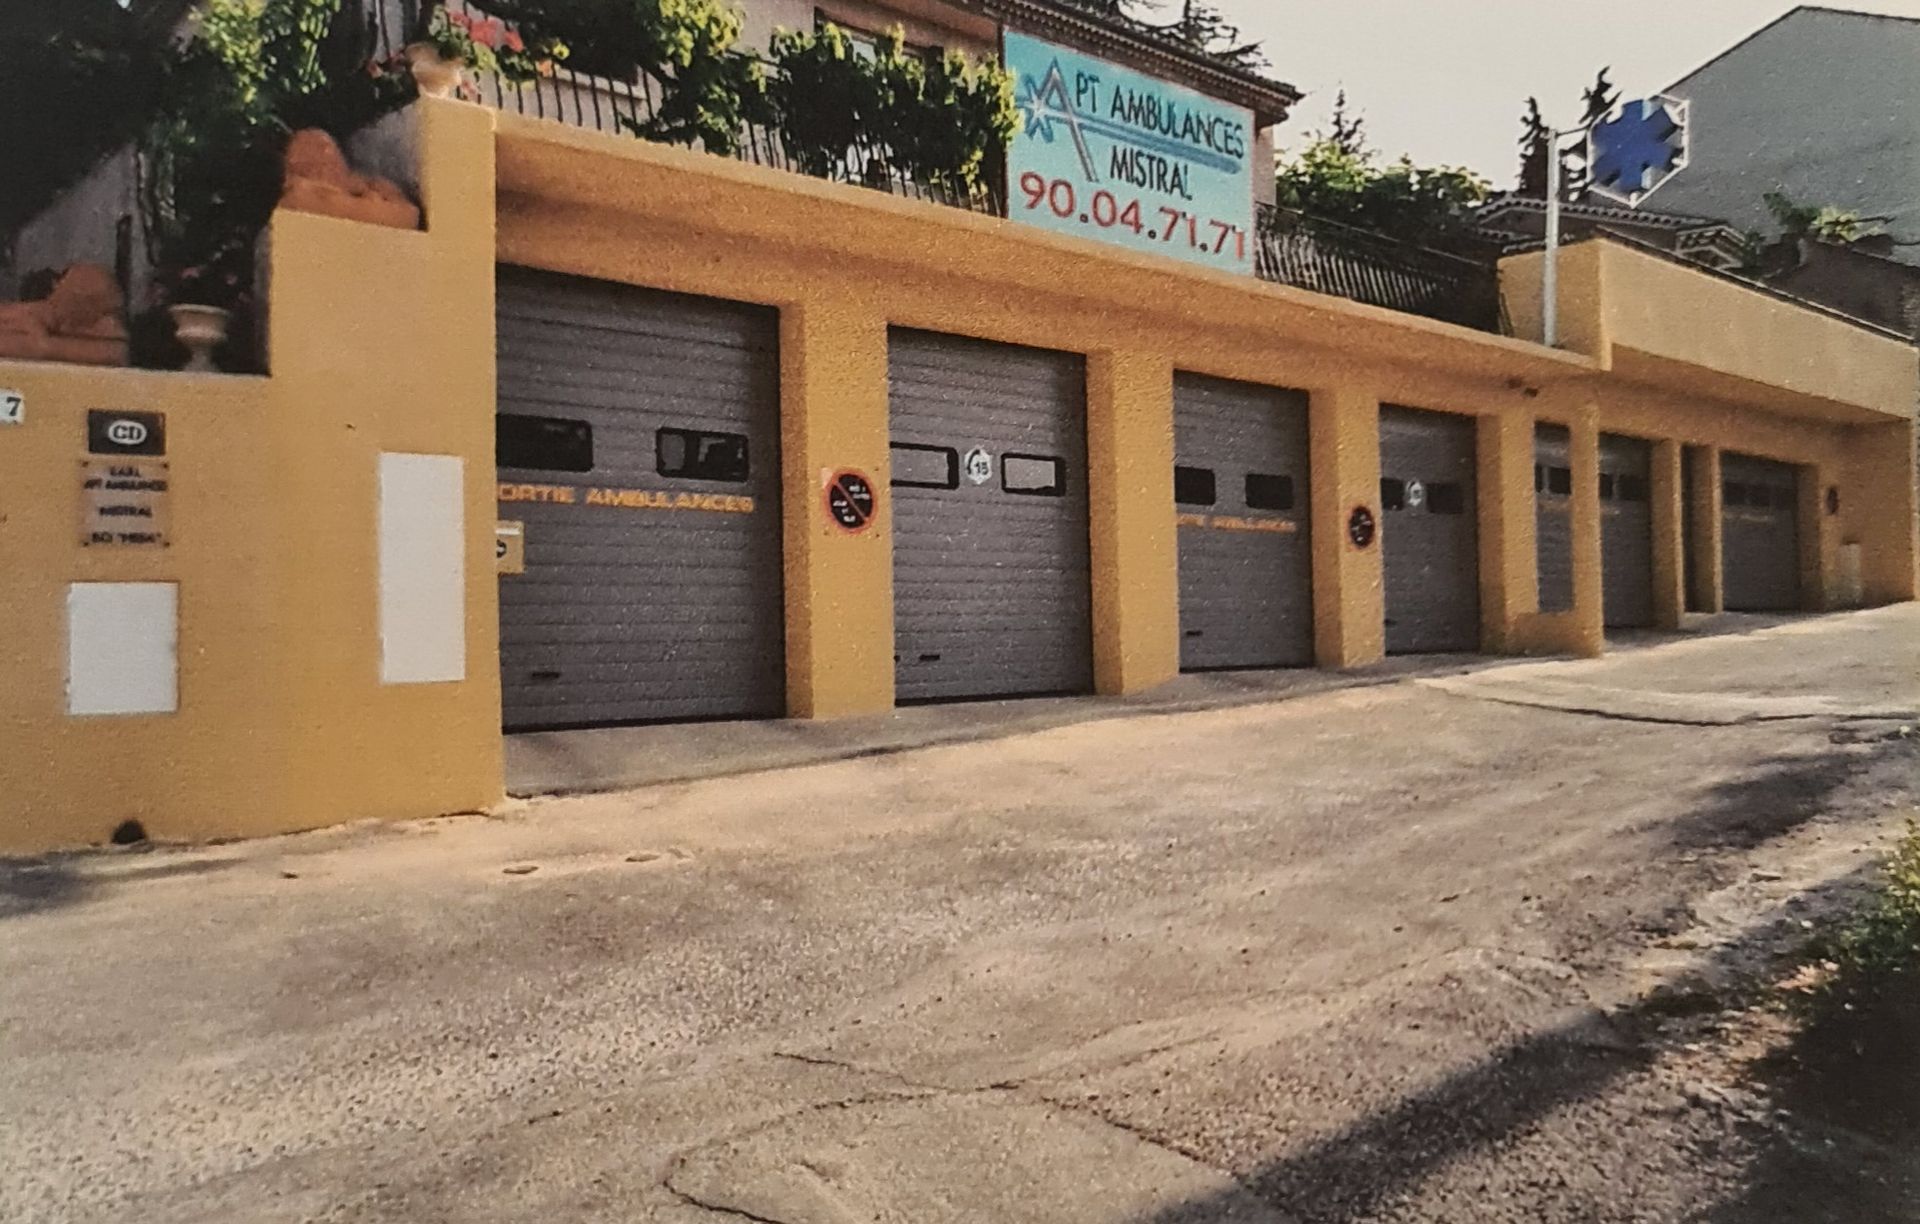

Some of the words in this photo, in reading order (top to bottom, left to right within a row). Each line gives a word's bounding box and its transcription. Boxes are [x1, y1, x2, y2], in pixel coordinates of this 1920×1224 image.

[1111, 85, 1244, 159] AMBULANCES
[1110, 145, 1192, 201] MISTRAL
[1020, 171, 1245, 261] 90.04.71.71
[6, 396, 21, 416] 7
[498, 484, 575, 503] ORTIE
[586, 487, 754, 512] AMBULANCES
